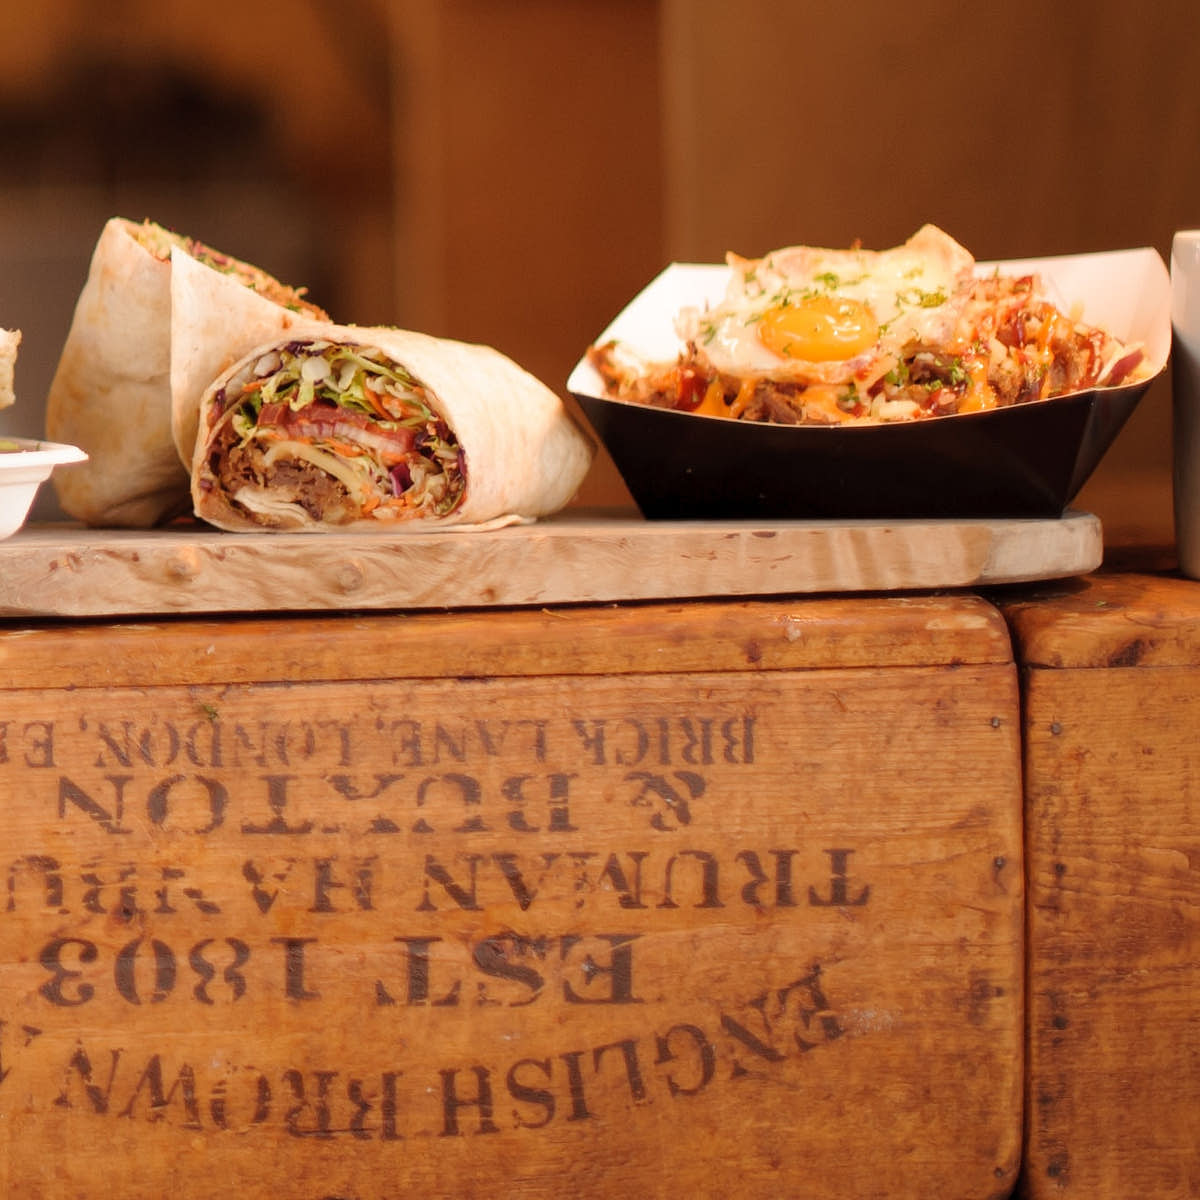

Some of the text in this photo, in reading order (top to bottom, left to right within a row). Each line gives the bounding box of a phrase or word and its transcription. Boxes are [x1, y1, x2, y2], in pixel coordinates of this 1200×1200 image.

[571, 716, 757, 766] BRICK
[57, 770, 707, 835] & BUXTON
[415, 848, 872, 910] TRUMAN
[39, 931, 646, 1007] EST 1803
[437, 960, 846, 1137] ENGLISH
[53, 1045, 404, 1140] BROWN
